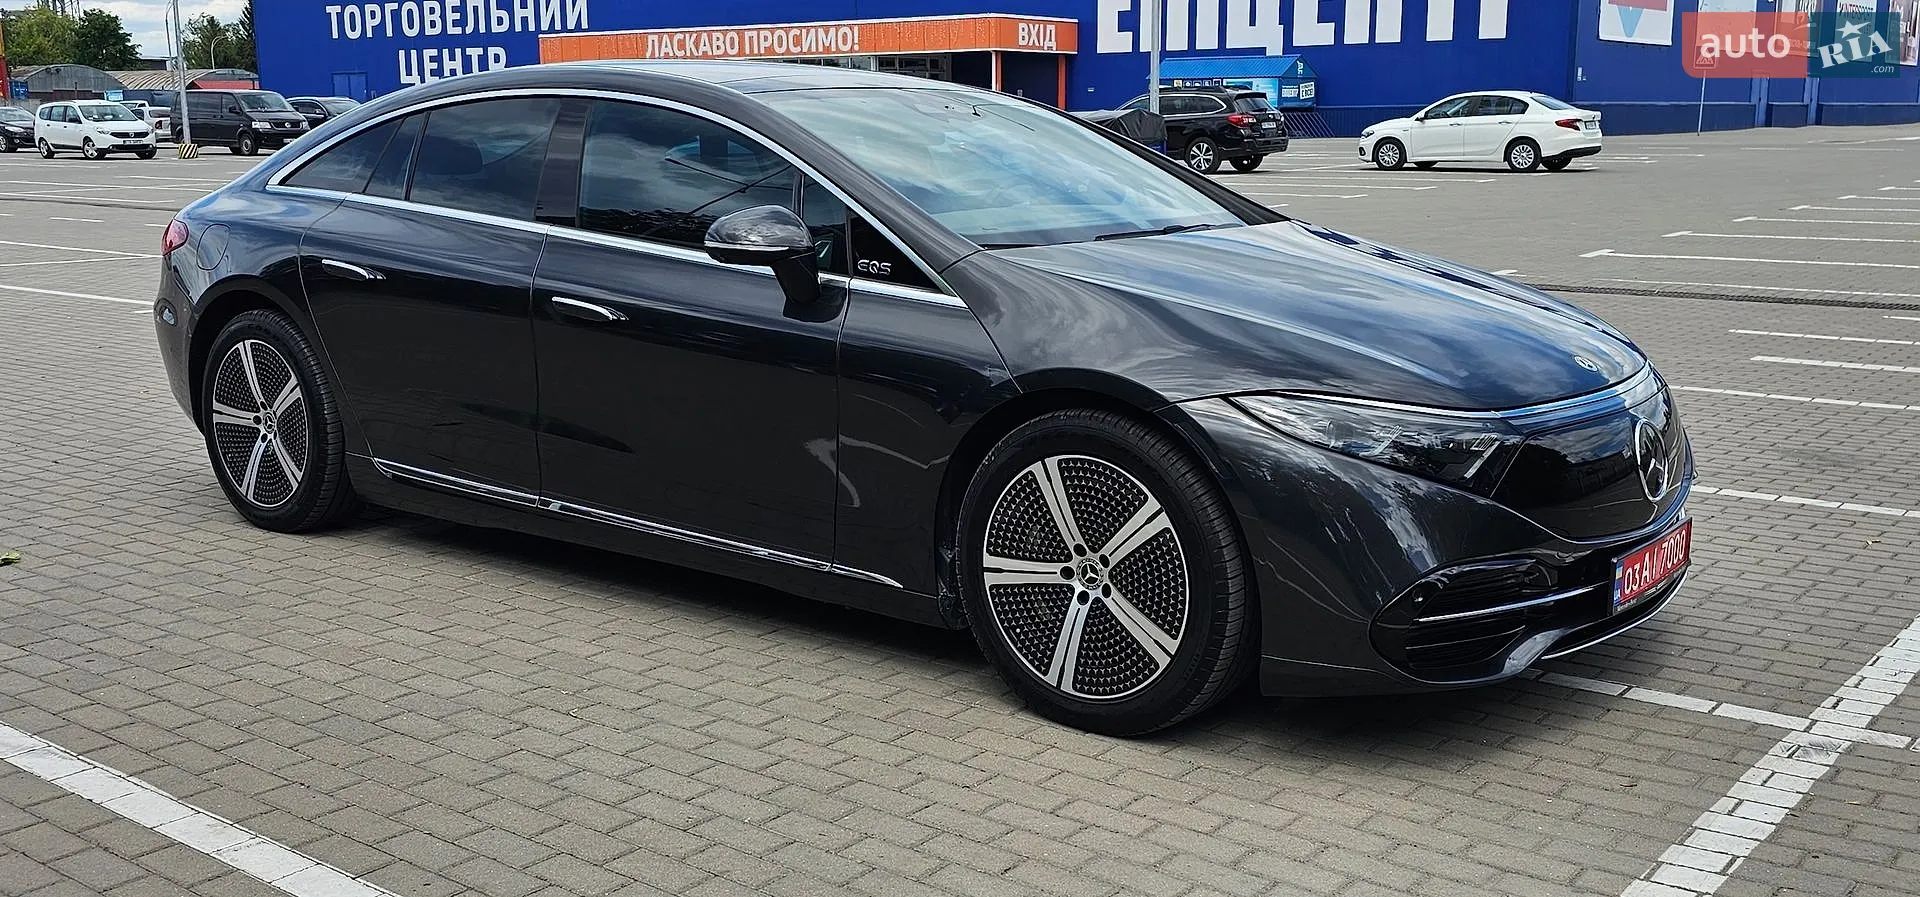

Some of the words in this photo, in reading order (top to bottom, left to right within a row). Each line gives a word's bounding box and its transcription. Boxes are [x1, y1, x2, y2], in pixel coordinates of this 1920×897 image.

[646, 30, 740, 59] ЛАСКАВО
[744, 26, 860, 55] ПРОСИМО!
[1017, 22, 1057, 51] ВХІД
[398, 46, 507, 85] ЦЕНТР
[857, 259, 892, 276] EQS
